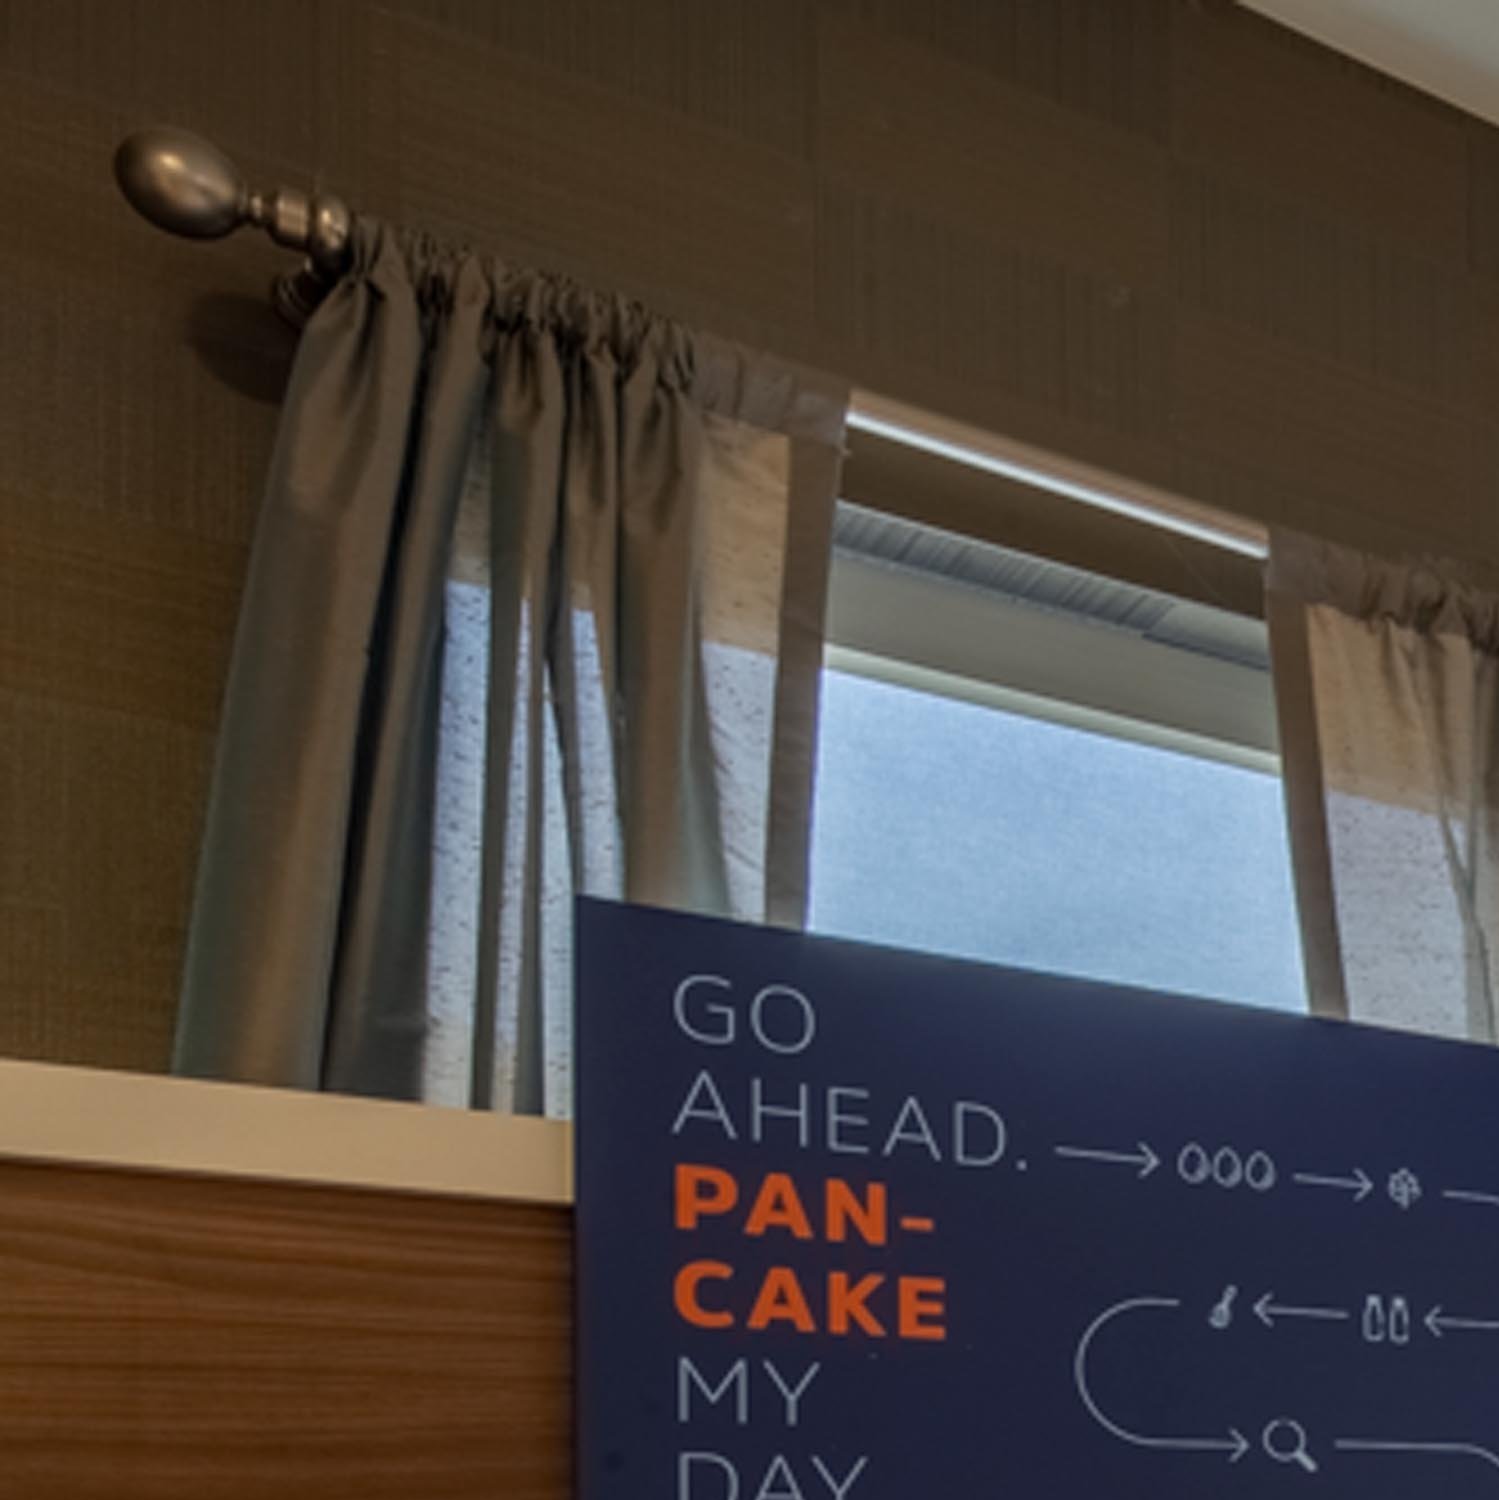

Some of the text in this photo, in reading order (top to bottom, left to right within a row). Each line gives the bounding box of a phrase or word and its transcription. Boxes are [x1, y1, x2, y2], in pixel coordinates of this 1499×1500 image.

[673, 974, 816, 1054] GO
[672, 1069, 1027, 1171] AHEAD.
[675, 1163, 934, 1246] PAN-
[673, 1259, 946, 1340] CAKE
[678, 1356, 821, 1426] MY
